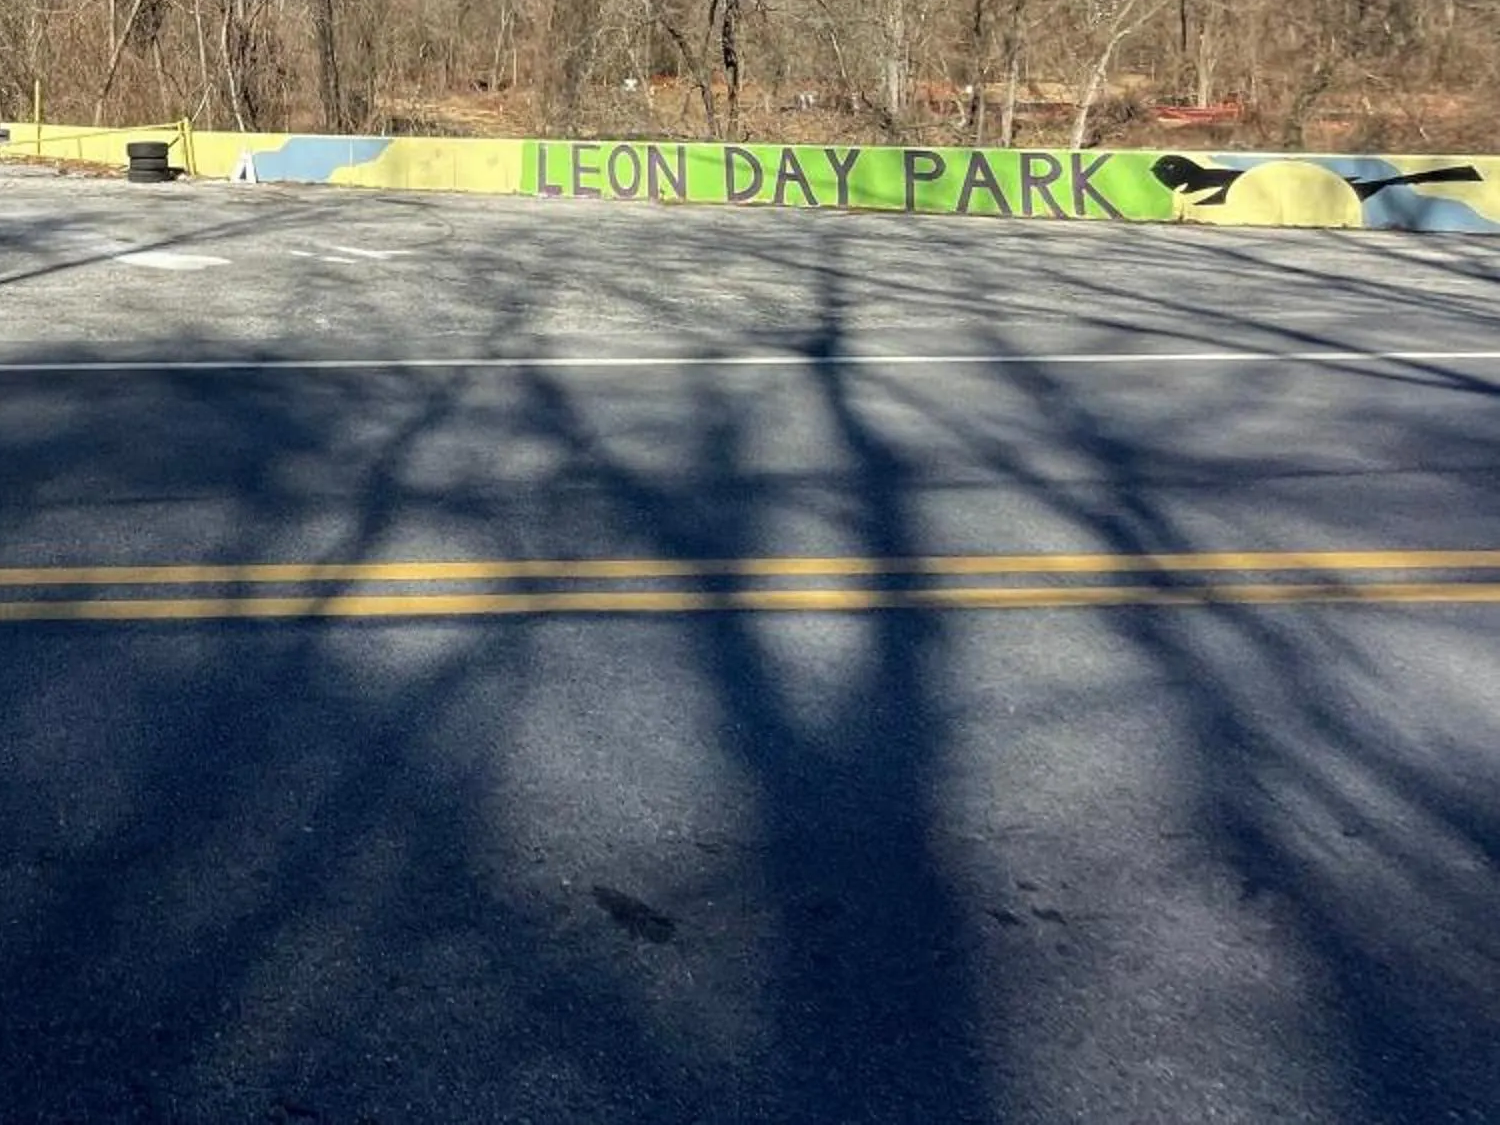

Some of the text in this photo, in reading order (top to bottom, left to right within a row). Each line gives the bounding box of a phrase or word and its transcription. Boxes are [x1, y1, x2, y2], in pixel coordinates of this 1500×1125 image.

[536, 142, 1123, 220] LEON DAY PARK
